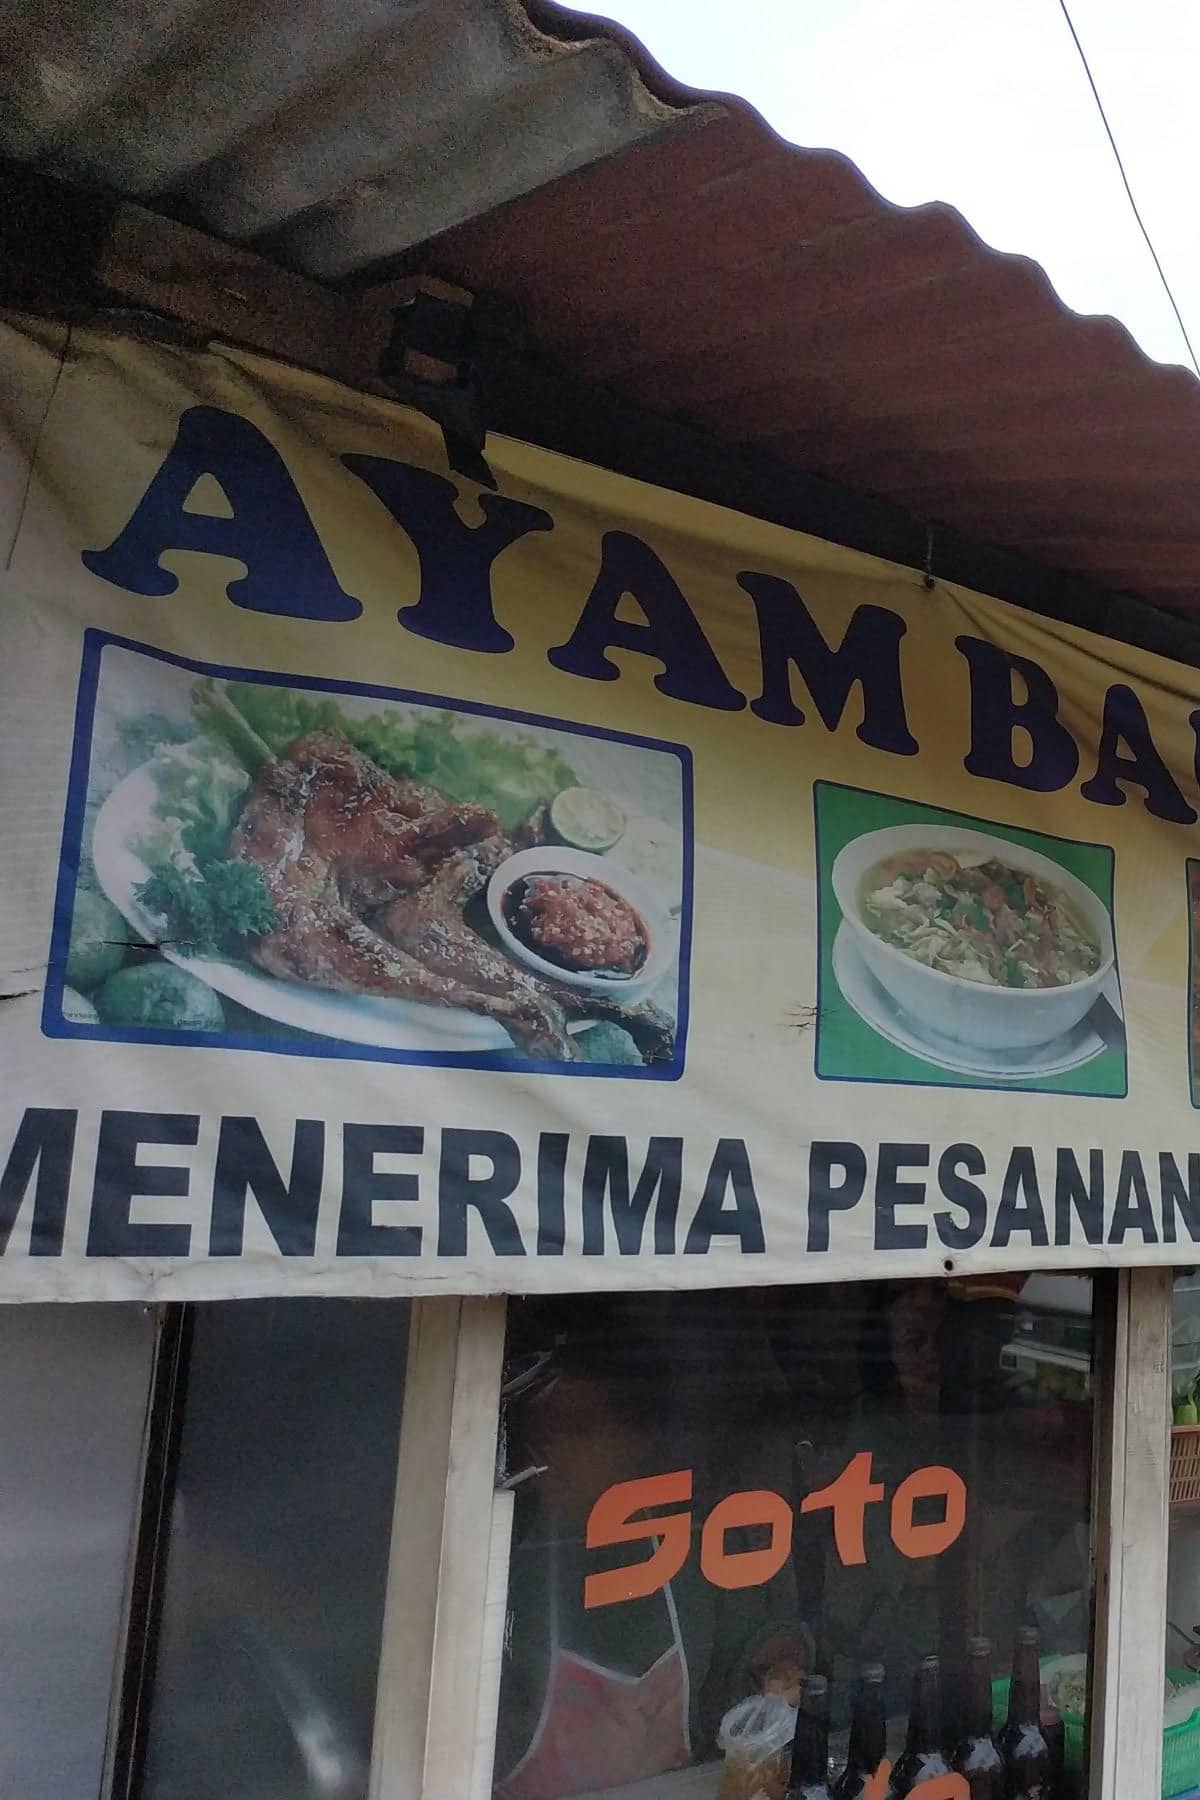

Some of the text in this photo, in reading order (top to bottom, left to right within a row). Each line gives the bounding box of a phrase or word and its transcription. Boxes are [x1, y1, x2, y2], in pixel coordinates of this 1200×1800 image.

[82, 404, 919, 756] AYAM
[0, 1107, 767, 1258] MENERIMA
[584, 1451, 967, 1609] Soto
